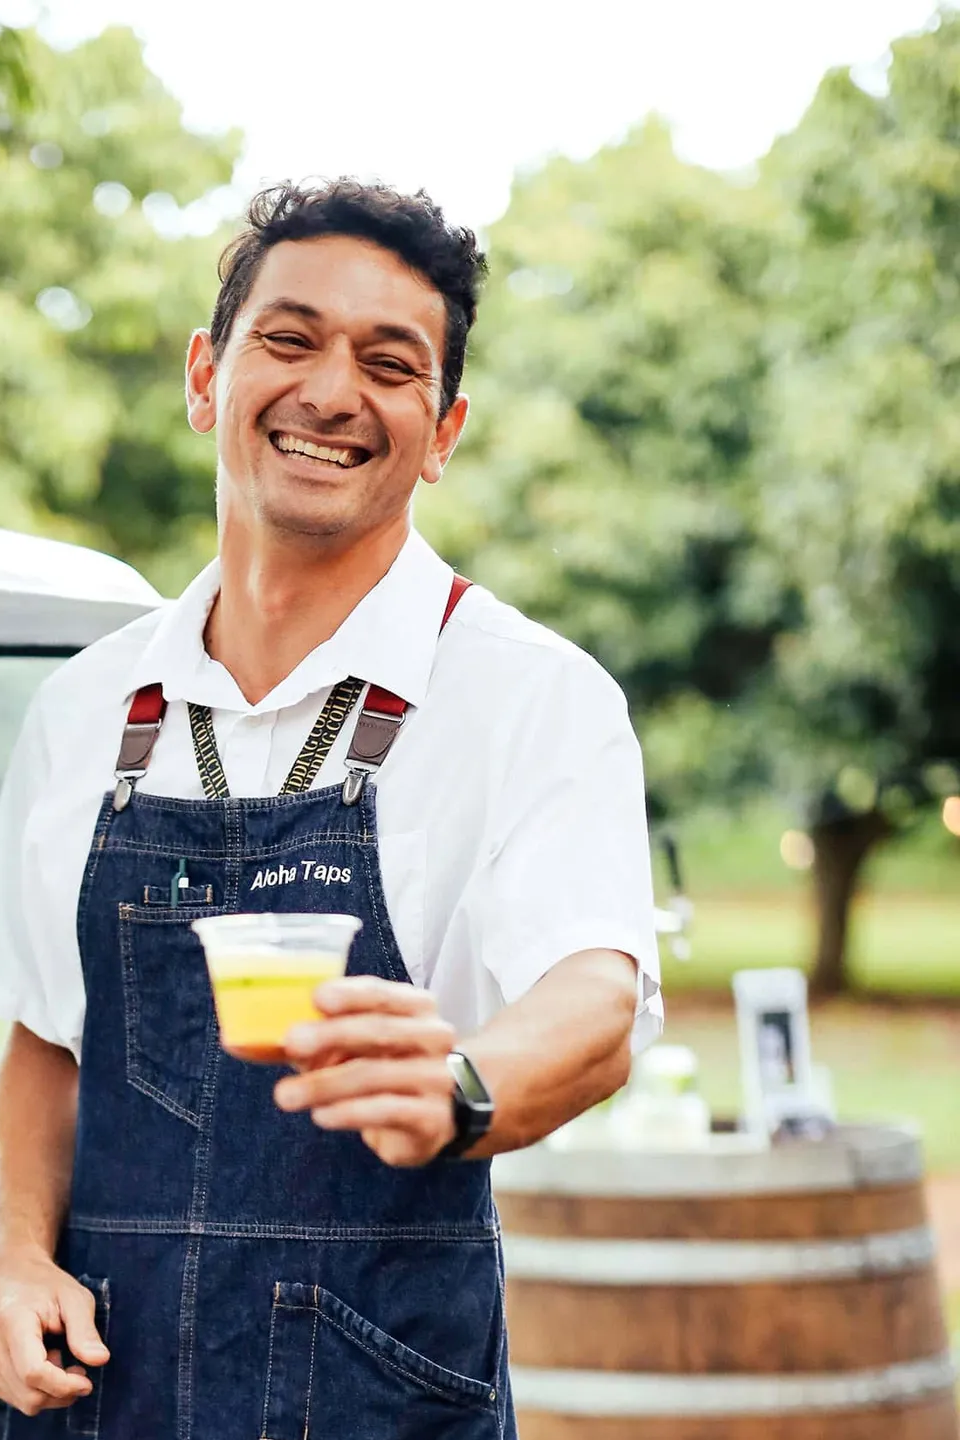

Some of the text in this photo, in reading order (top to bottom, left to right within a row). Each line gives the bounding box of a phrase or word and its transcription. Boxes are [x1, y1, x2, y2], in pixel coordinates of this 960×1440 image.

[285, 741, 319, 796] EDDING
[301, 732, 337, 790] EDDING
[250, 860, 351, 891] Aloha Taps
